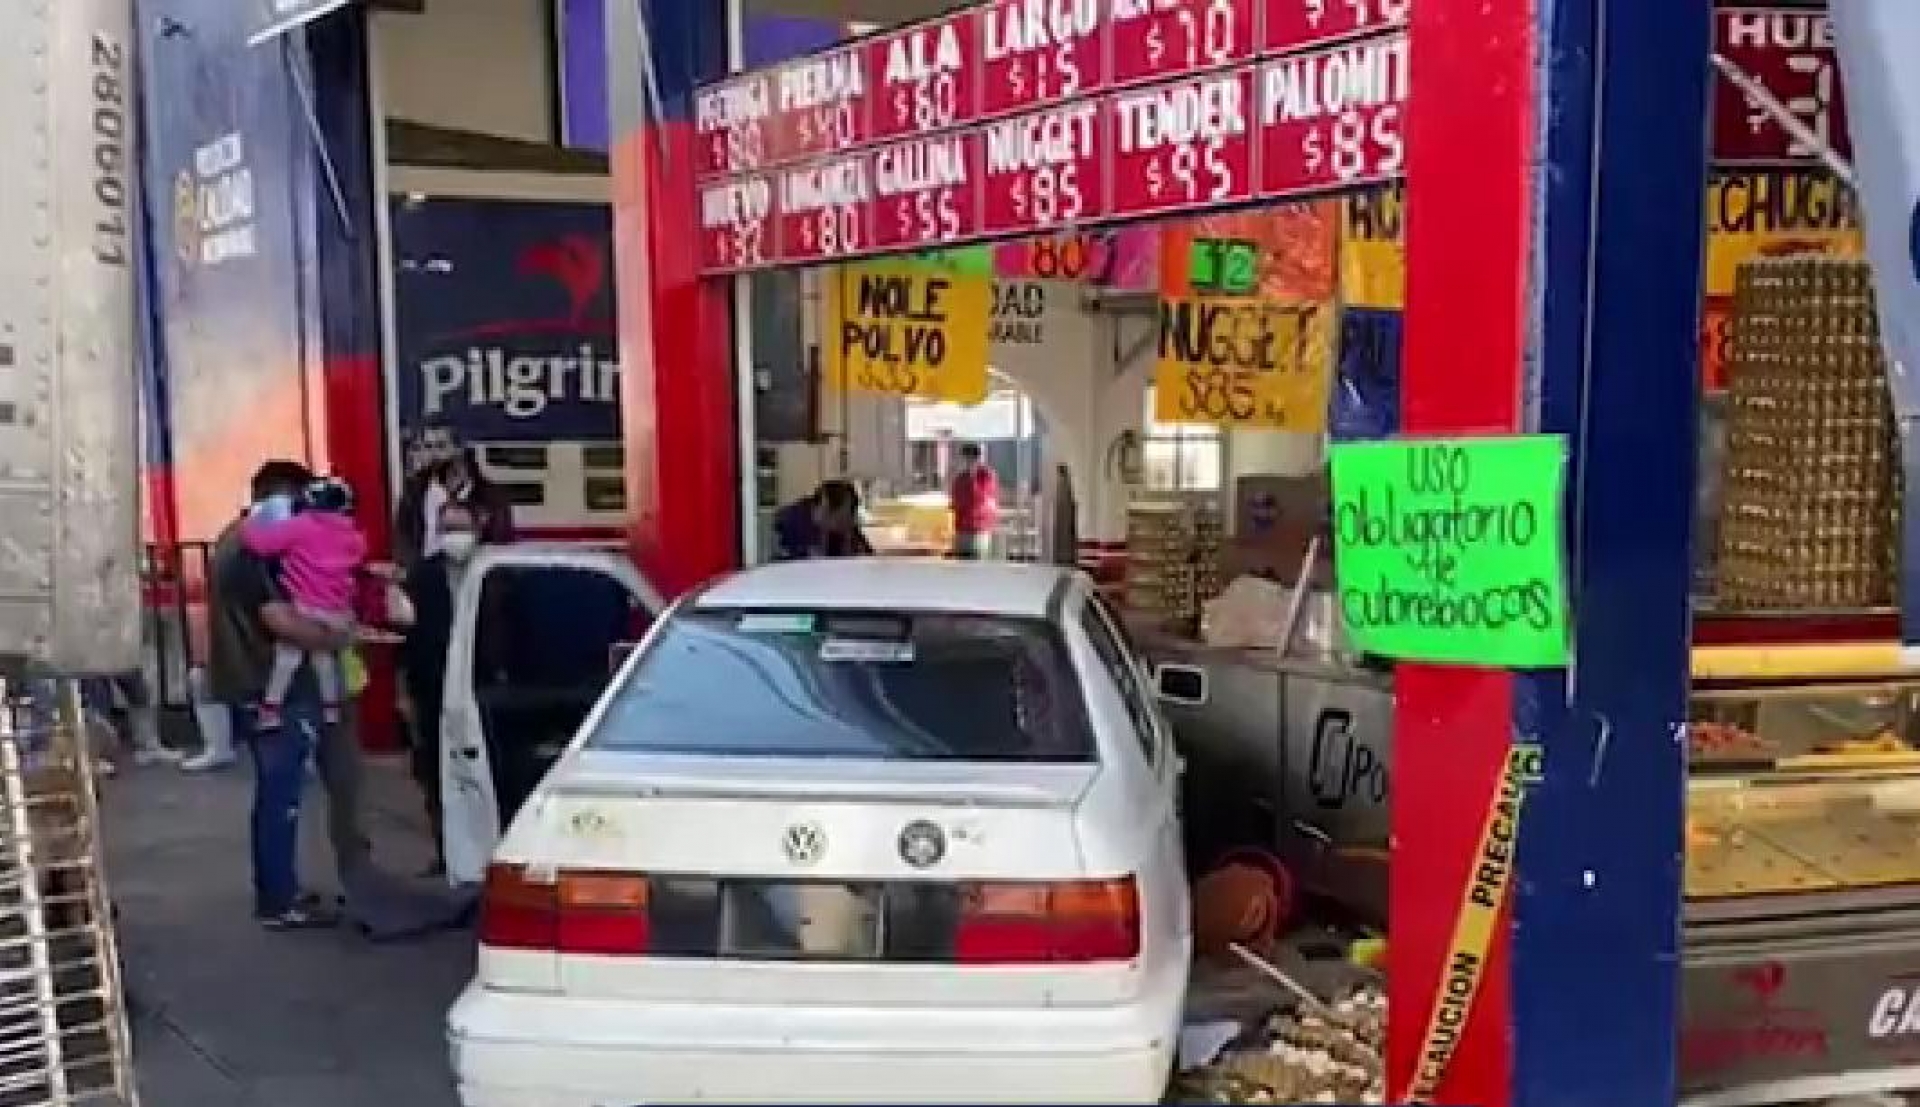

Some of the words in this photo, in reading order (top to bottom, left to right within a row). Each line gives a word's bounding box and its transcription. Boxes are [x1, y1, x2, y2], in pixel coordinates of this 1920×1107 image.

[884, 24, 962, 83] ALA
[1116, 72, 1246, 153] TENDER
[1302, 107, 1404, 181] $85
